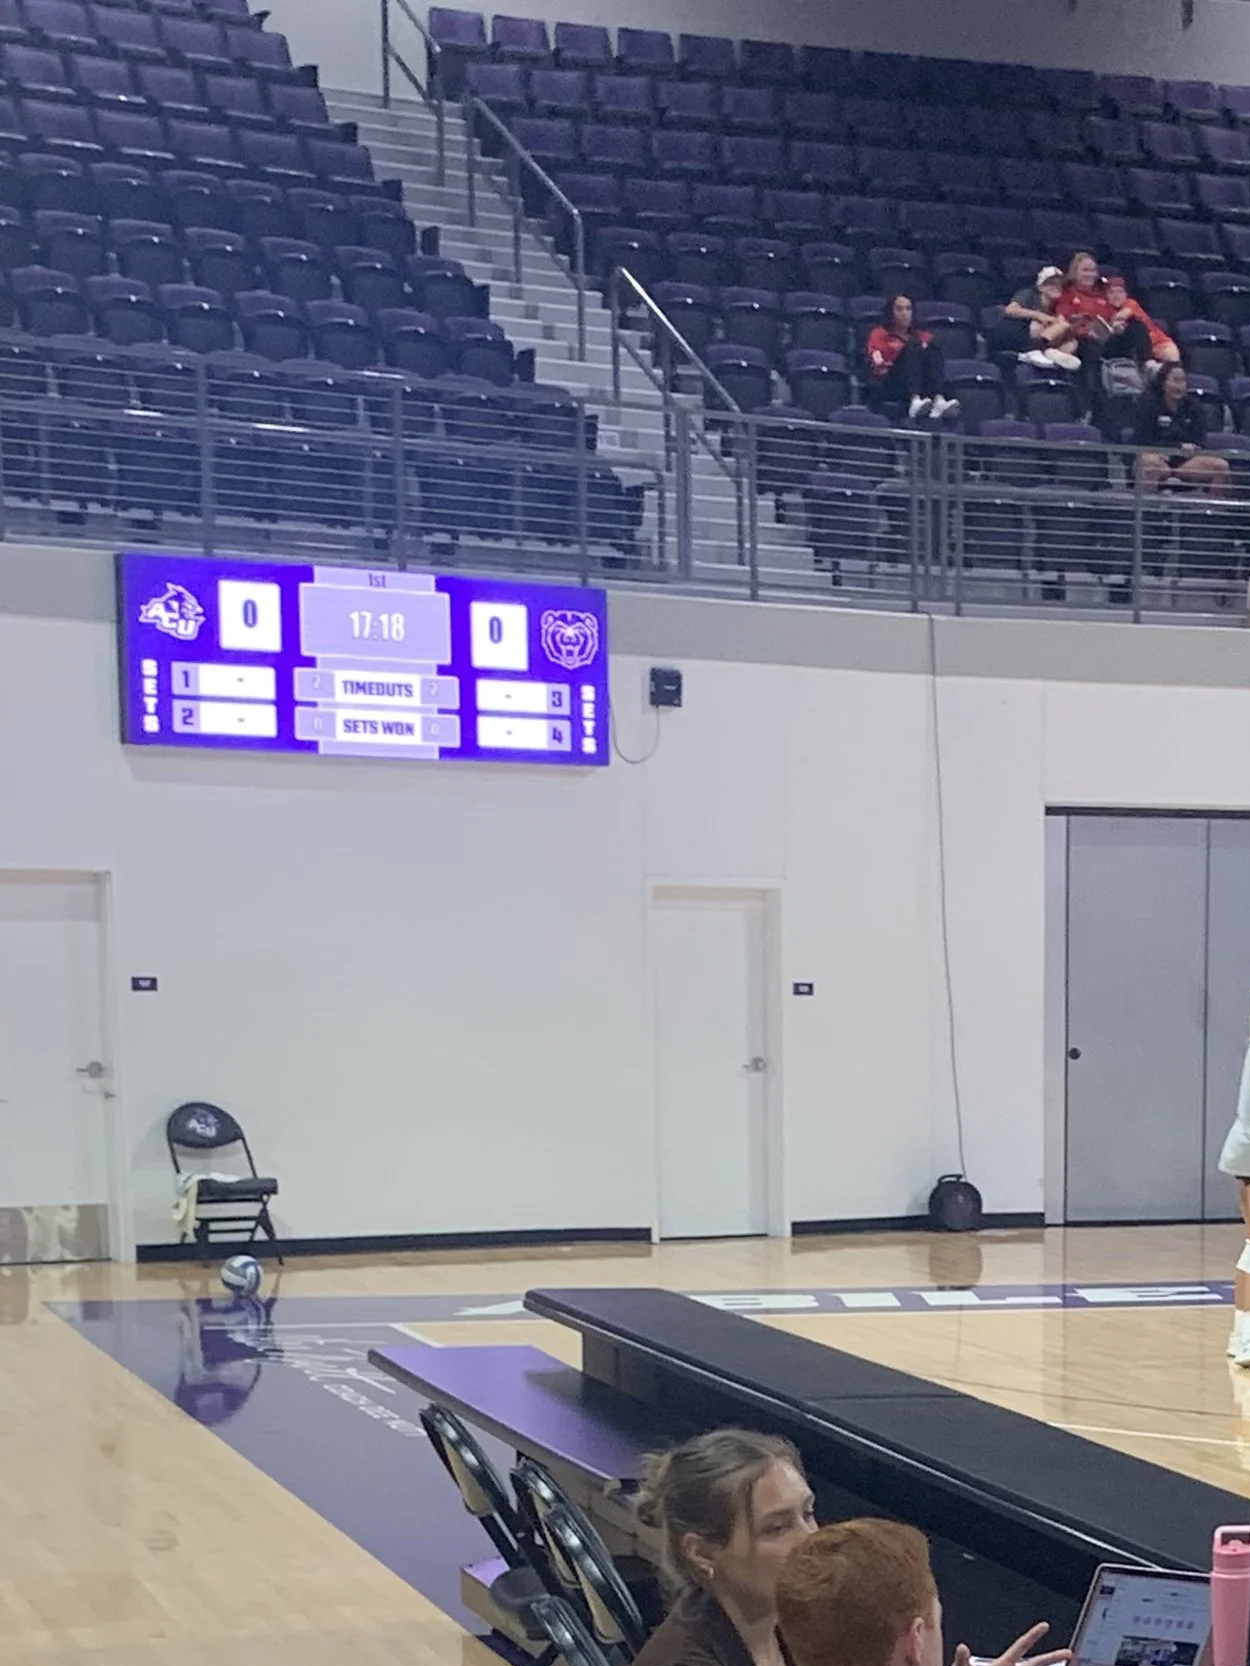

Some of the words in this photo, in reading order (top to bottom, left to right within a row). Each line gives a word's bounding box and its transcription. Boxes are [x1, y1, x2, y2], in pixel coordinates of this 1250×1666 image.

[368, 573, 386, 588] 1st
[242, 599, 258, 628] 0
[349, 610, 405, 642] 17:18
[489, 616, 502, 644] 0
[342, 680, 414, 698] TIMEOUTS
[552, 691, 563, 707] 3
[182, 708, 194, 726] 2
[343, 719, 378, 734] SETS
[382, 722, 415, 736] WON
[552, 728, 563, 744] 4
